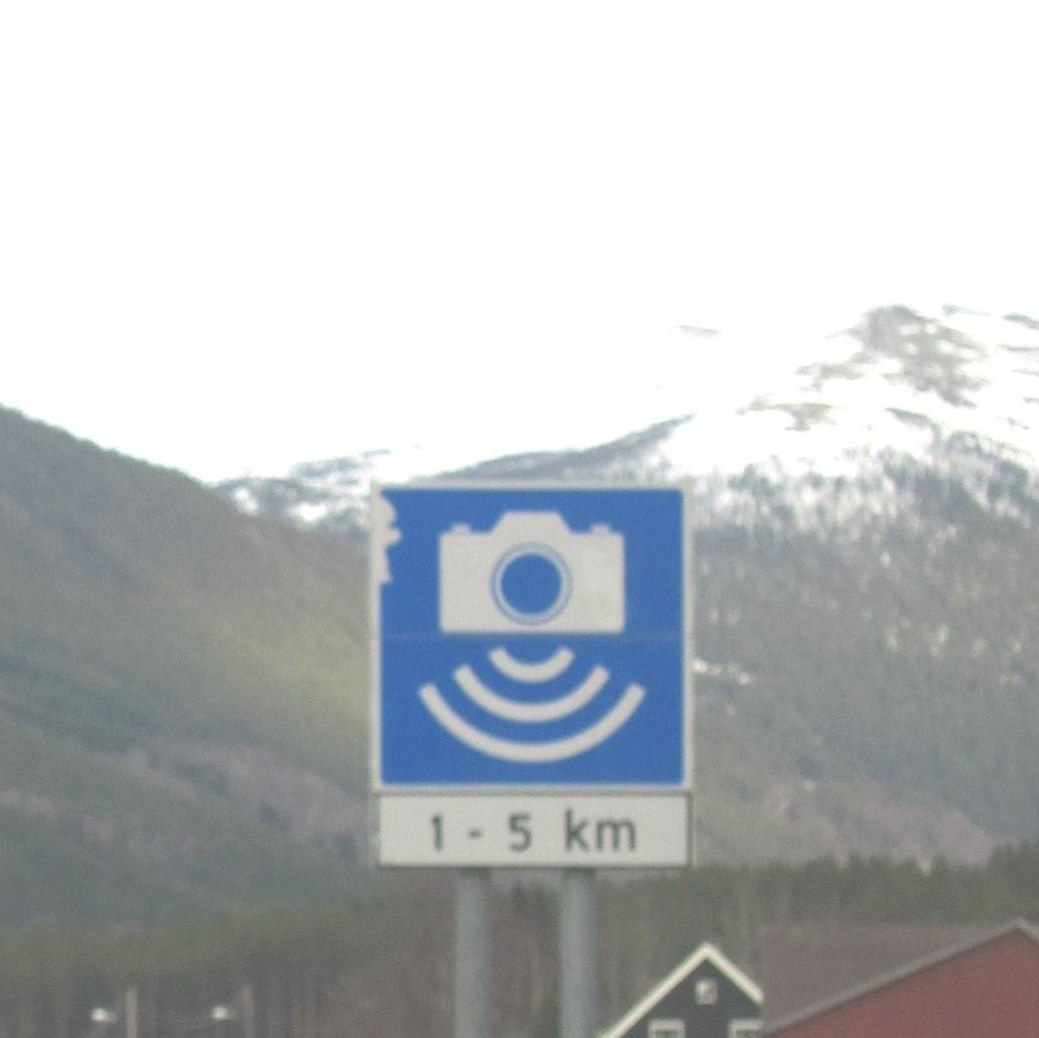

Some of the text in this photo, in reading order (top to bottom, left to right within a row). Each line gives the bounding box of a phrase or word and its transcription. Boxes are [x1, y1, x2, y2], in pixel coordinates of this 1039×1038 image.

[431, 812, 443, 851] 1
[508, 812, 532, 852] 5
[564, 808, 637, 851] km
